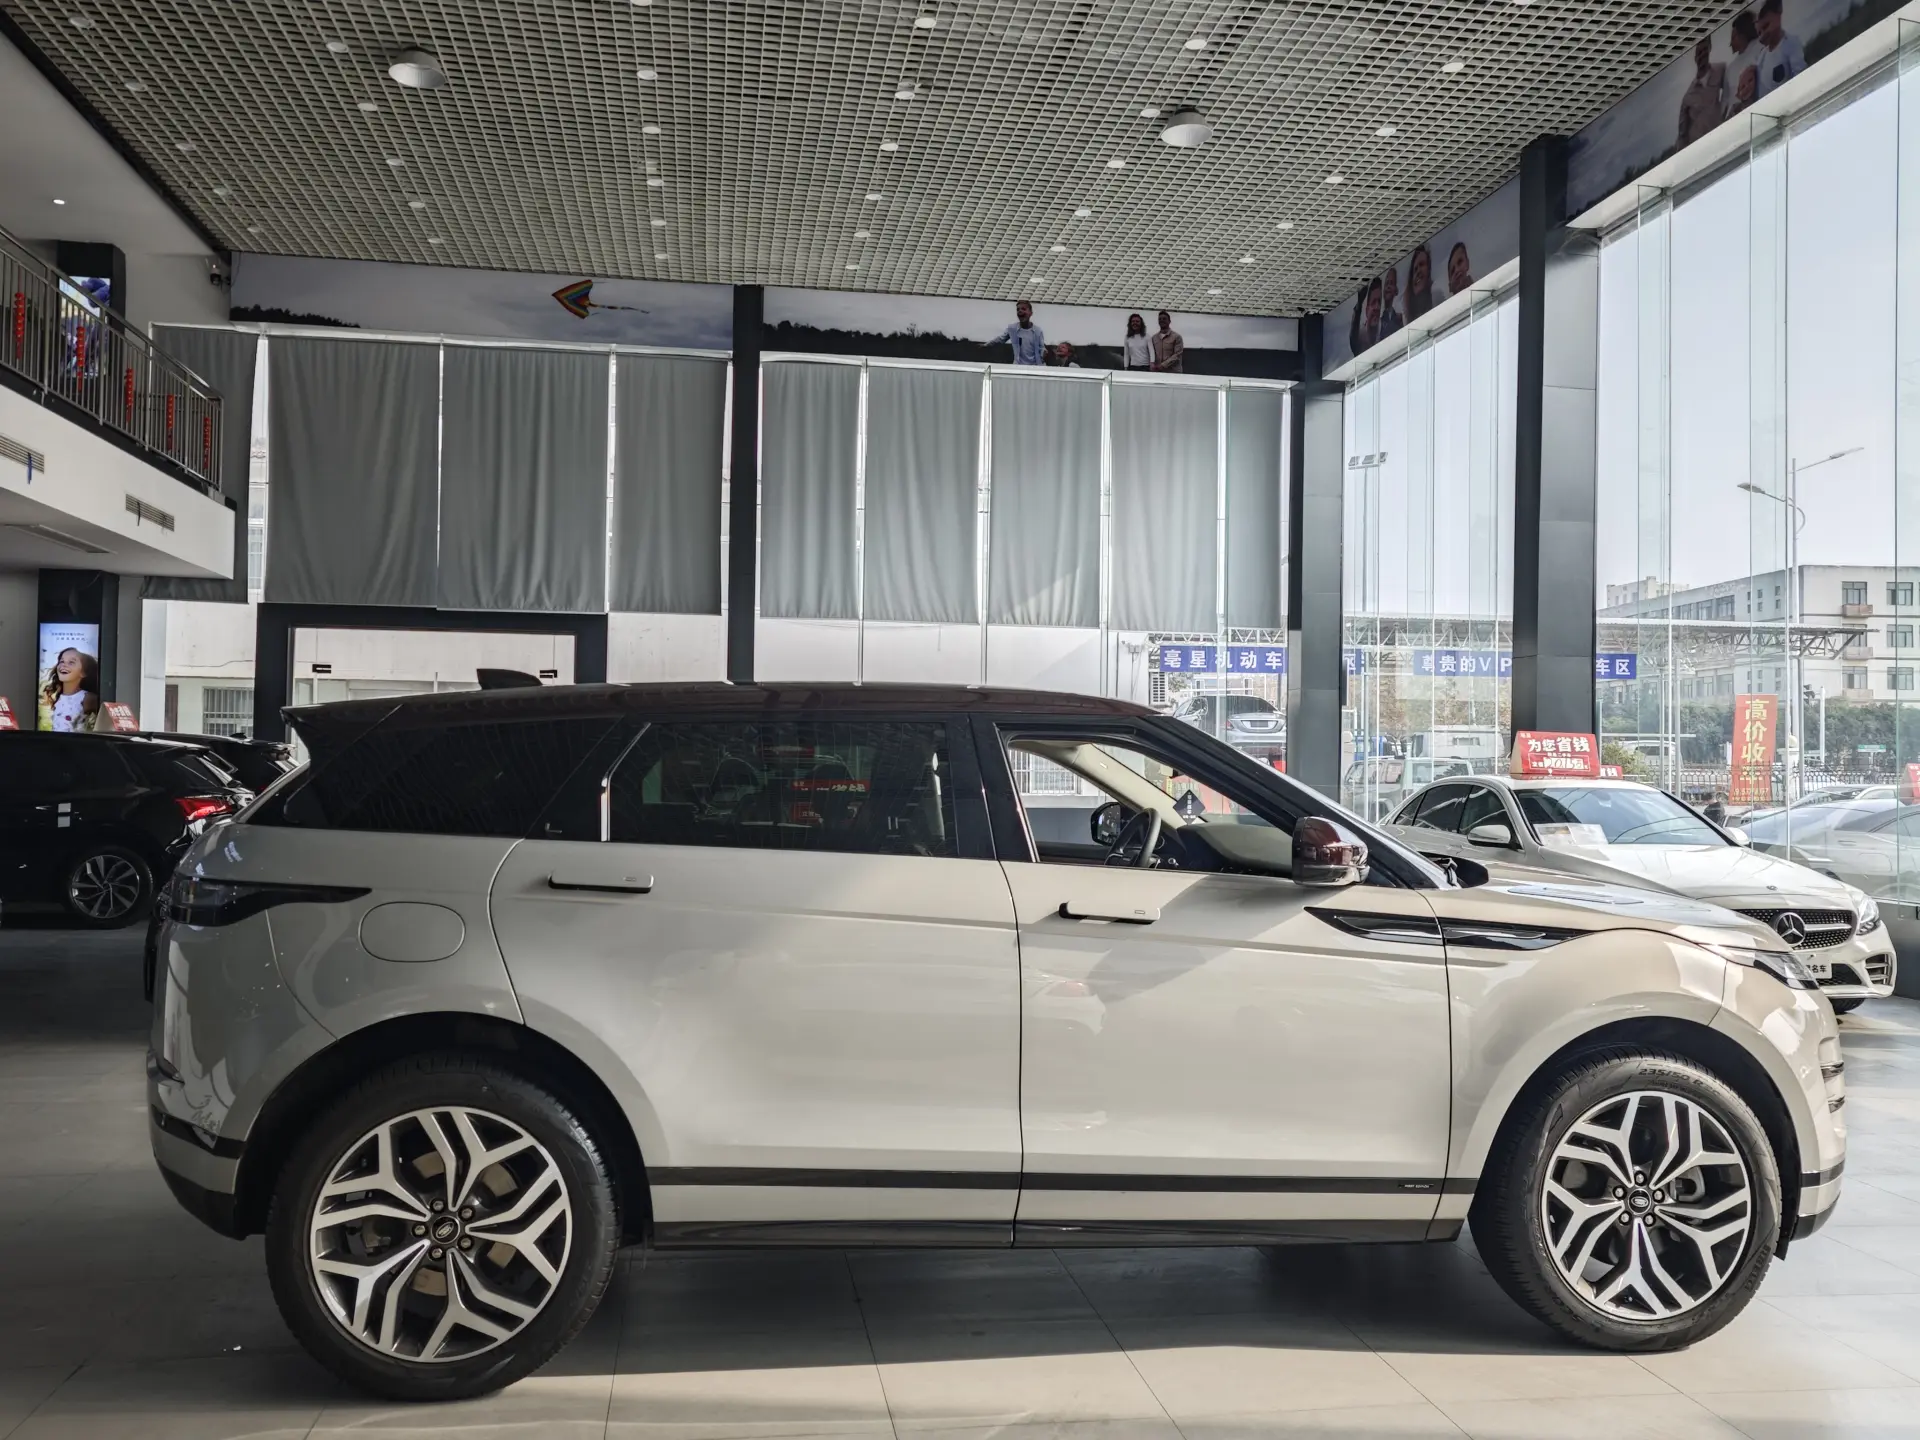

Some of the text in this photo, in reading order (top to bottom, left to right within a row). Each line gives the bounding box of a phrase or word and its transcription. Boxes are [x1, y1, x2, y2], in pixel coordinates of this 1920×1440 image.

[1421, 655, 1512, 673] 尊贵的VP
[1528, 737, 1590, 752] 为您省钱
[1639, 1068, 1690, 1081] 235/50
